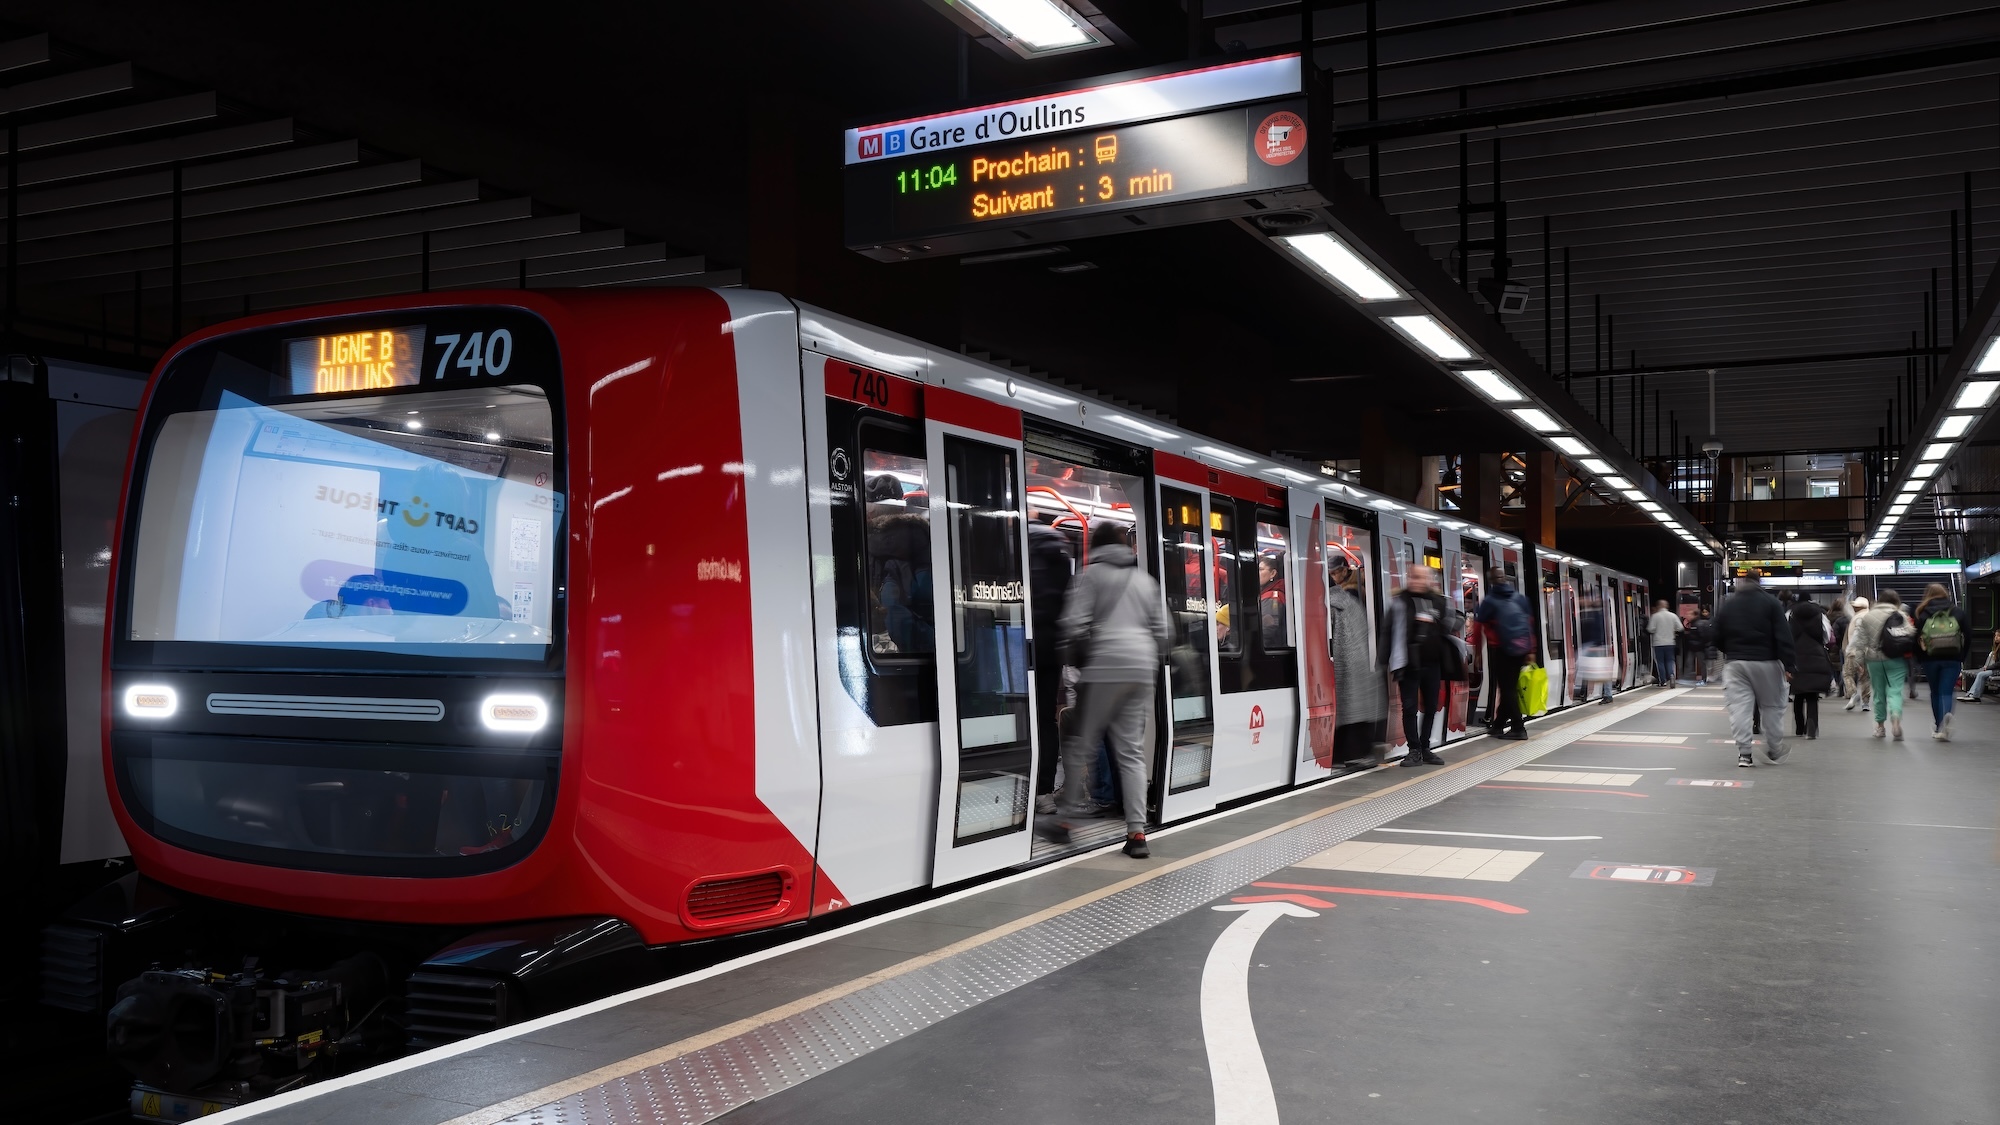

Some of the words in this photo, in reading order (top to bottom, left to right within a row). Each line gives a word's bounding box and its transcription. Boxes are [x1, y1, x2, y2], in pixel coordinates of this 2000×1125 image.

[863, 139, 879, 156] M
[889, 134, 901, 151] B
[910, 126, 966, 151] Gare
[975, 104, 1086, 140] d'Oullins
[897, 163, 957, 194] 11:04
[972, 147, 1070, 183] Prochain
[972, 186, 1054, 218] Suivant
[1098, 176, 1113, 200] 3
[1129, 168, 1173, 196] min
[320, 333, 373, 366] LIGNE
[380, 331, 394, 361] B
[435, 328, 513, 380] 740
[317, 361, 395, 394] OULLINS
[848, 367, 889, 407] 740
[831, 482, 853, 492] ALSTOM
